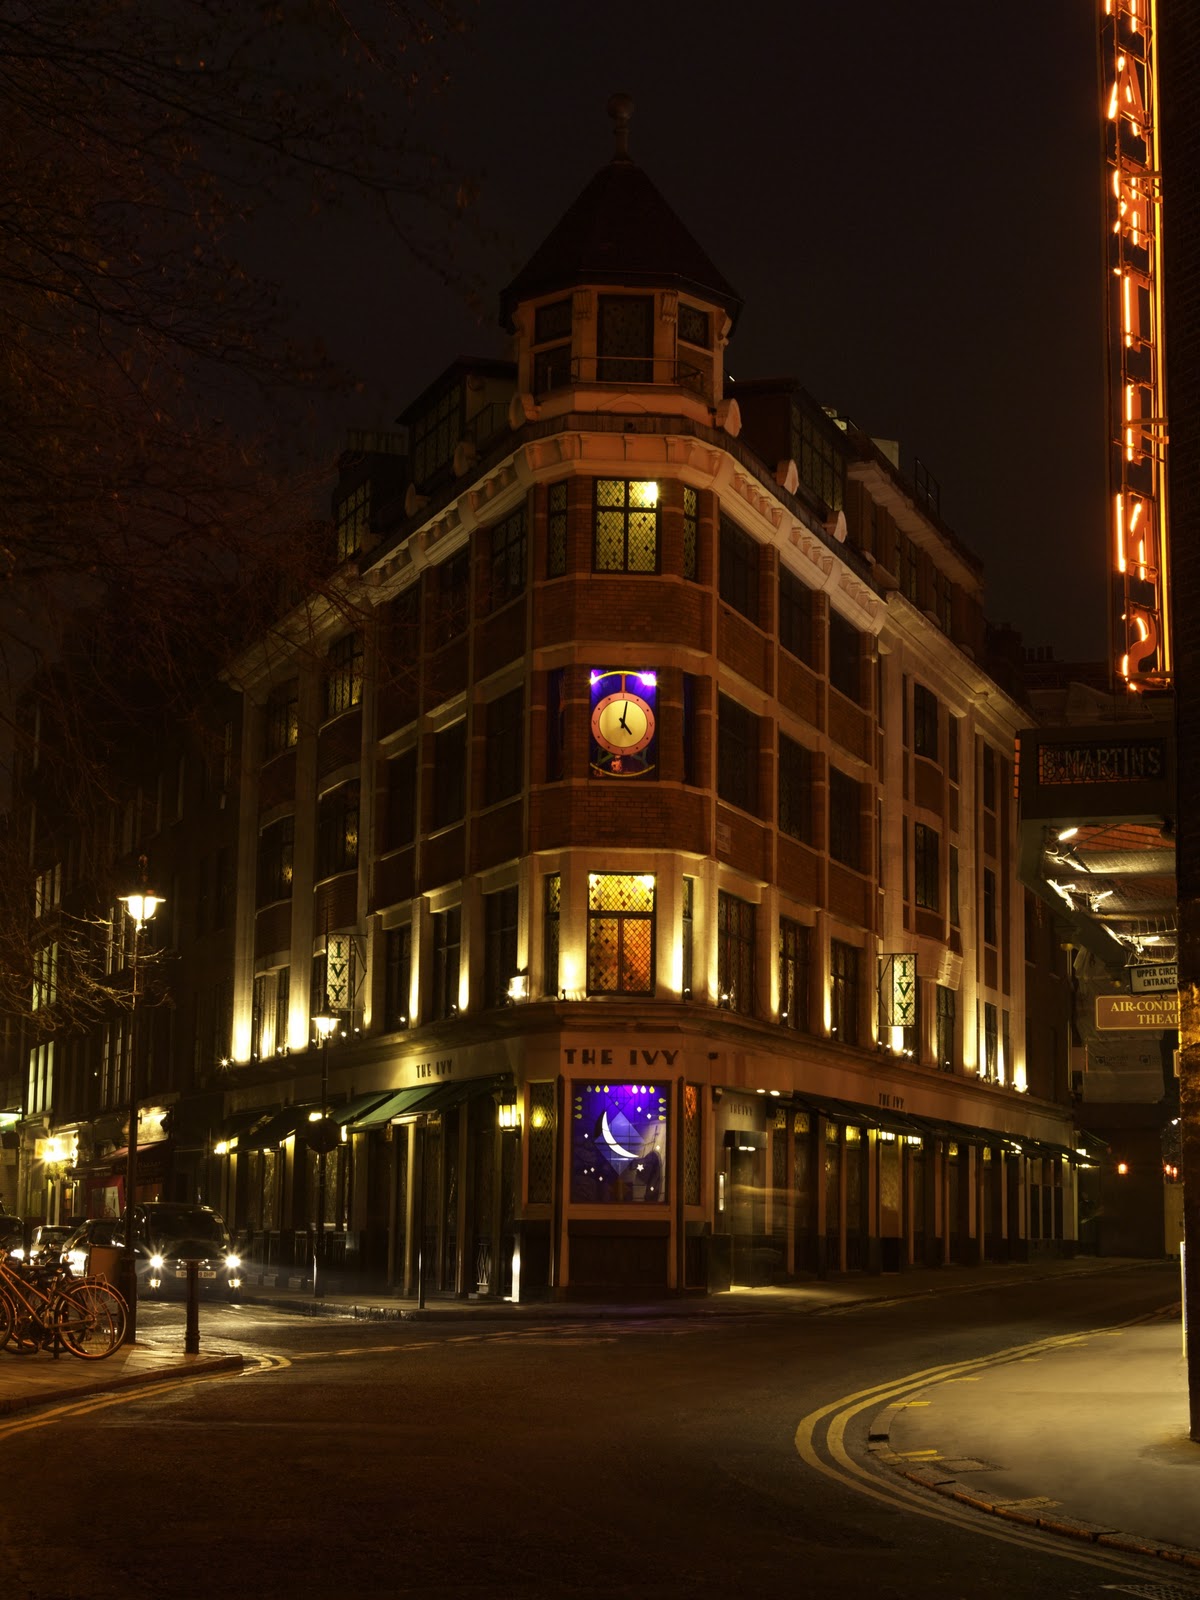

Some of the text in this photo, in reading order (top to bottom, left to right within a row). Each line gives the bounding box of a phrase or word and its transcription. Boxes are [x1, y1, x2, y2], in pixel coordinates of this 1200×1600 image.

[328, 941, 347, 1002] IVY
[1136, 968, 1157, 978] UPPER
[896, 960, 914, 1019] IVY
[1143, 977, 1176, 987] ENTRANCE
[1110, 1001, 1178, 1012] AIR-CONDI
[564, 1048, 679, 1066] THE IVY
[416, 1059, 453, 1079] THE IVY
[729, 1103, 753, 1116] THE IVY
[878, 1093, 905, 1110] THE IVY
